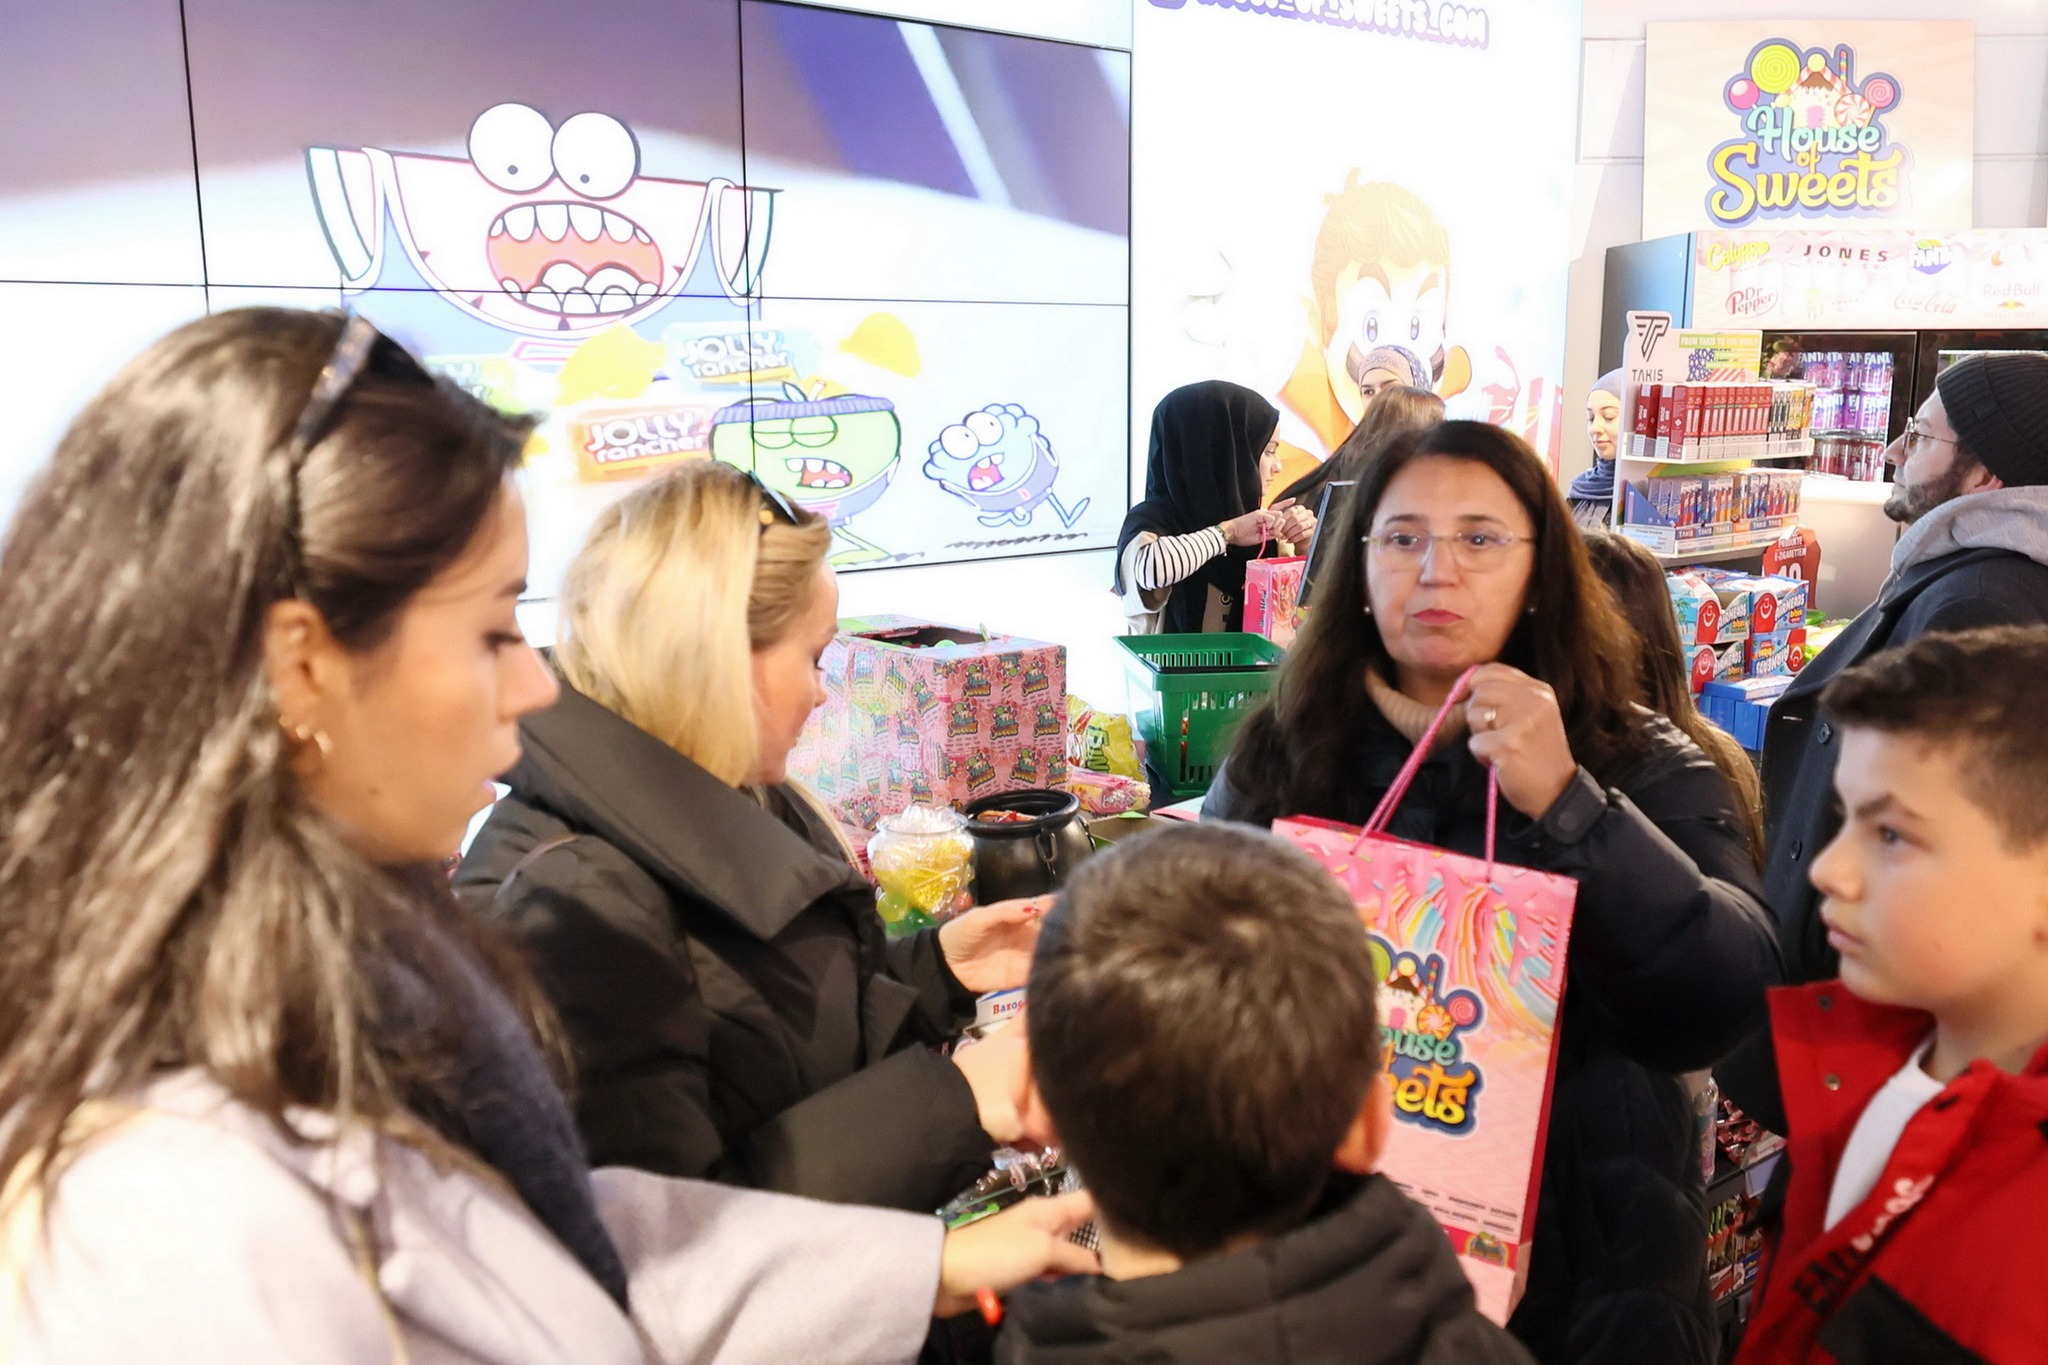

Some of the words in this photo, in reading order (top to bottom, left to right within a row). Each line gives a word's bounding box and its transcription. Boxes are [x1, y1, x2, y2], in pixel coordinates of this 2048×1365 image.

[1747, 105, 1880, 161] House
[1796, 140, 1821, 174] of
[1711, 141, 1904, 220] Sweets
[1803, 244, 1888, 263] JONES
[1740, 286, 1763, 301] Dr
[1984, 282, 2012, 297] Red
[2014, 282, 2041, 297] Bull
[1726, 290, 1774, 316] Pepper
[683, 330, 778, 365] JOLLY
[1681, 336, 1698, 347] FROM
[1699, 336, 1716, 347] TAKIS
[1716, 336, 1726, 346] TO
[694, 350, 788, 378] rancher
[1632, 369, 1664, 382] TAKIS
[588, 412, 695, 451] JOLLY
[595, 432, 707, 463] rancher
[1679, 529, 1694, 538] TAKIS
[1698, 526, 1713, 536] TAKIS
[1753, 520, 1767, 530] TAKIS
[1768, 518, 1782, 528] TAKIS
[1388, 1062, 1476, 1124] ets
